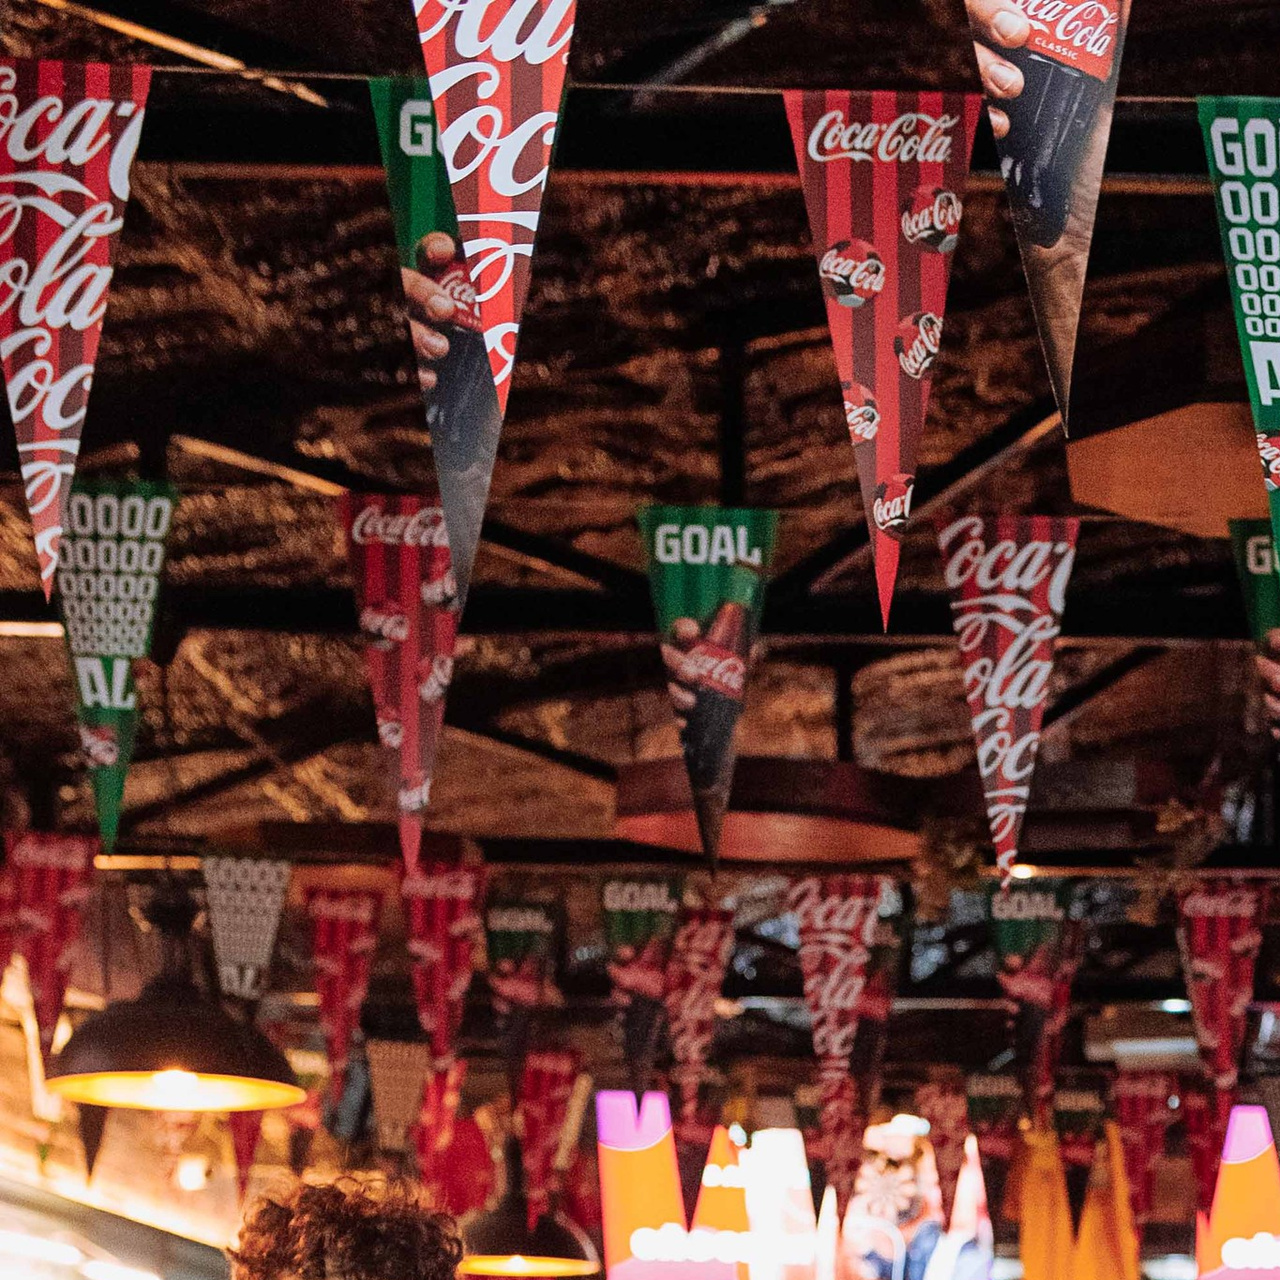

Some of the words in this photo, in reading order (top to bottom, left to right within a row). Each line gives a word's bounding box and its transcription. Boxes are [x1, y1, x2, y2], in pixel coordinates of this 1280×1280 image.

[1034, 37, 1078, 60] CLASSIC
[808, 110, 960, 162] Coca-Cola
[655, 523, 763, 566] GOAL
[74, 656, 136, 710] AL
